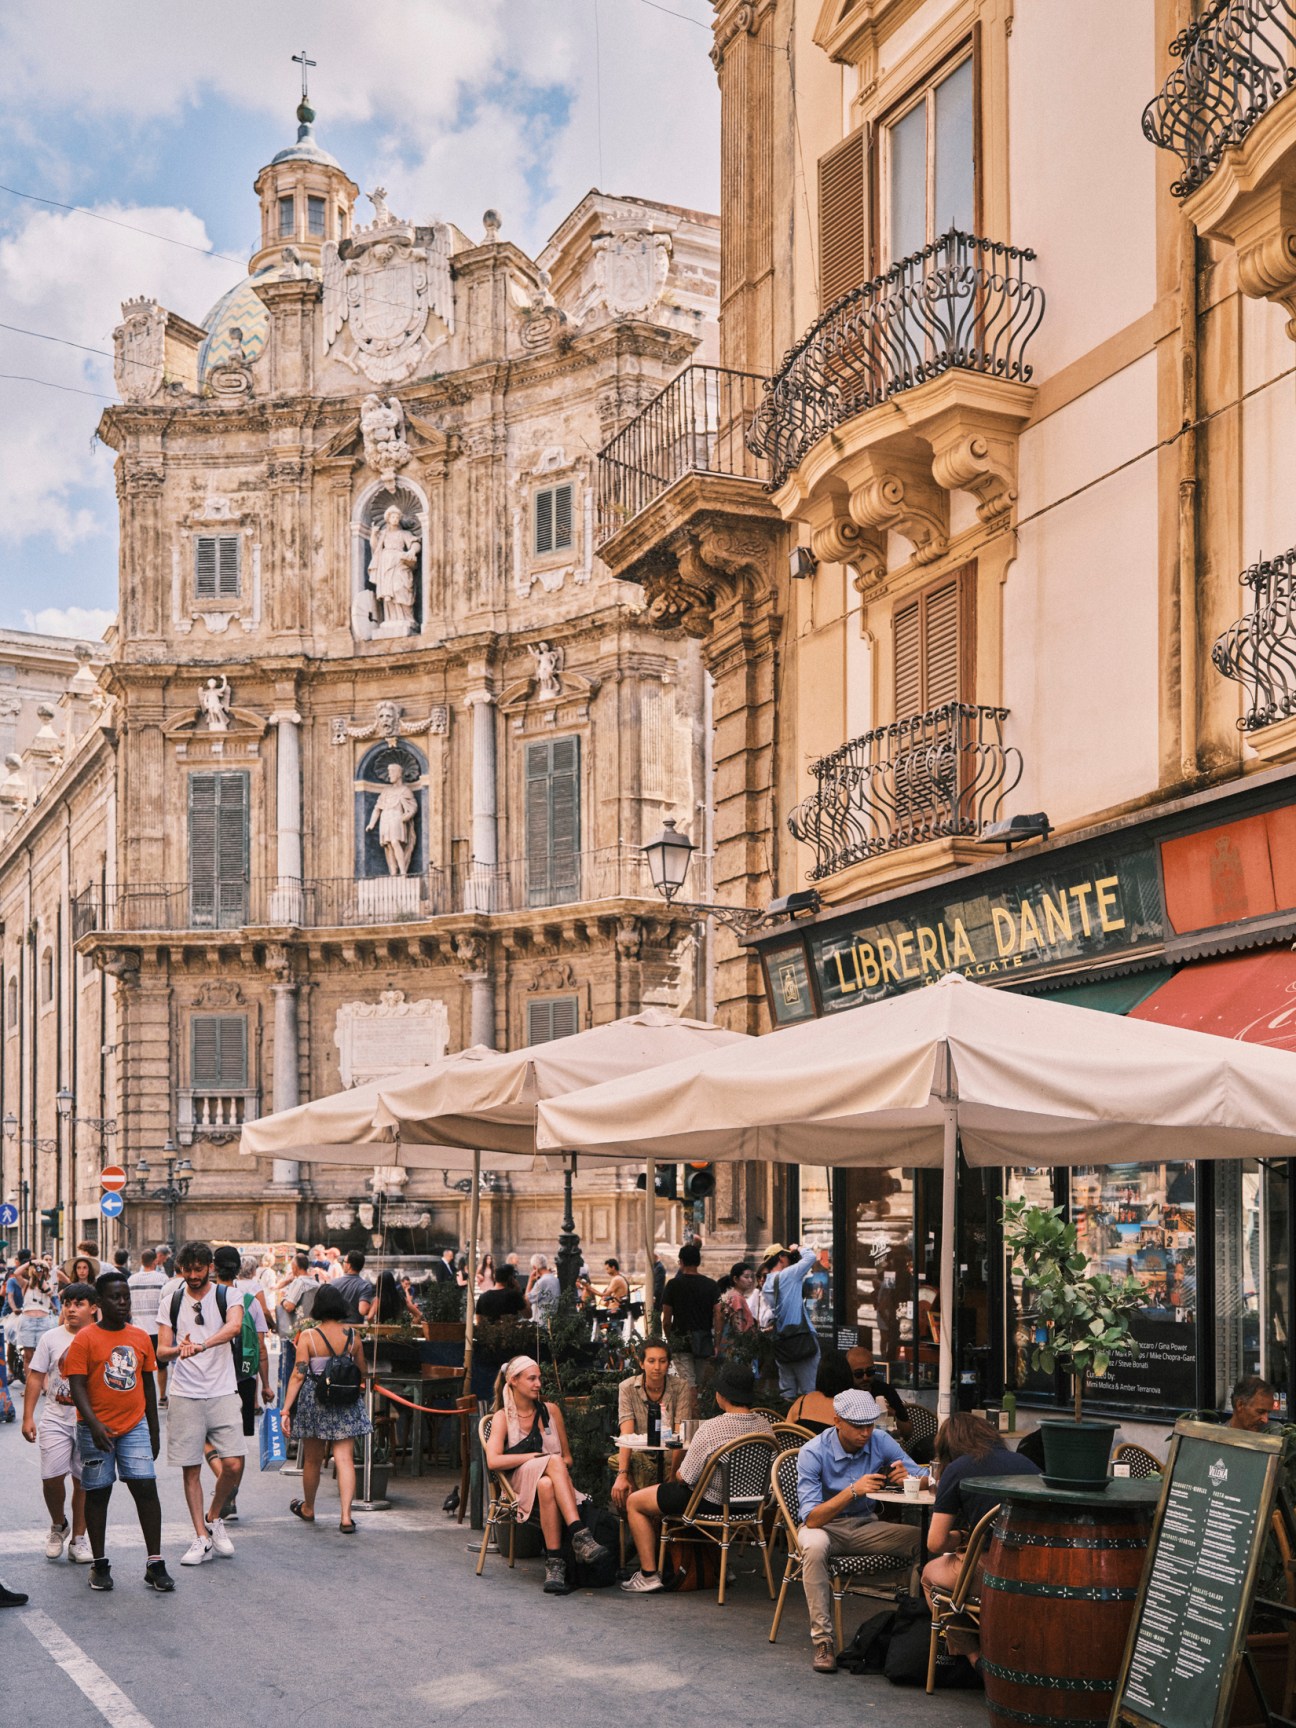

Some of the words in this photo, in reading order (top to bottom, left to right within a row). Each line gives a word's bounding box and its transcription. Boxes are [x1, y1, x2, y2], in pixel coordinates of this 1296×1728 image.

[835, 918, 976, 993] LIBRERIA
[992, 875, 1126, 957] DANTE
[1158, 1342, 1170, 1351] Gina
[1171, 1342, 1188, 1351] Power
[1149, 1352, 1162, 1360] Mike
[1118, 1360, 1132, 1368] Steve
[1098, 1381, 1115, 1390] Mollica
[1120, 1383, 1136, 1392] Amber
[1137, 1384, 1161, 1394] Terranova
[272, 1435, 281, 1457] LAB
